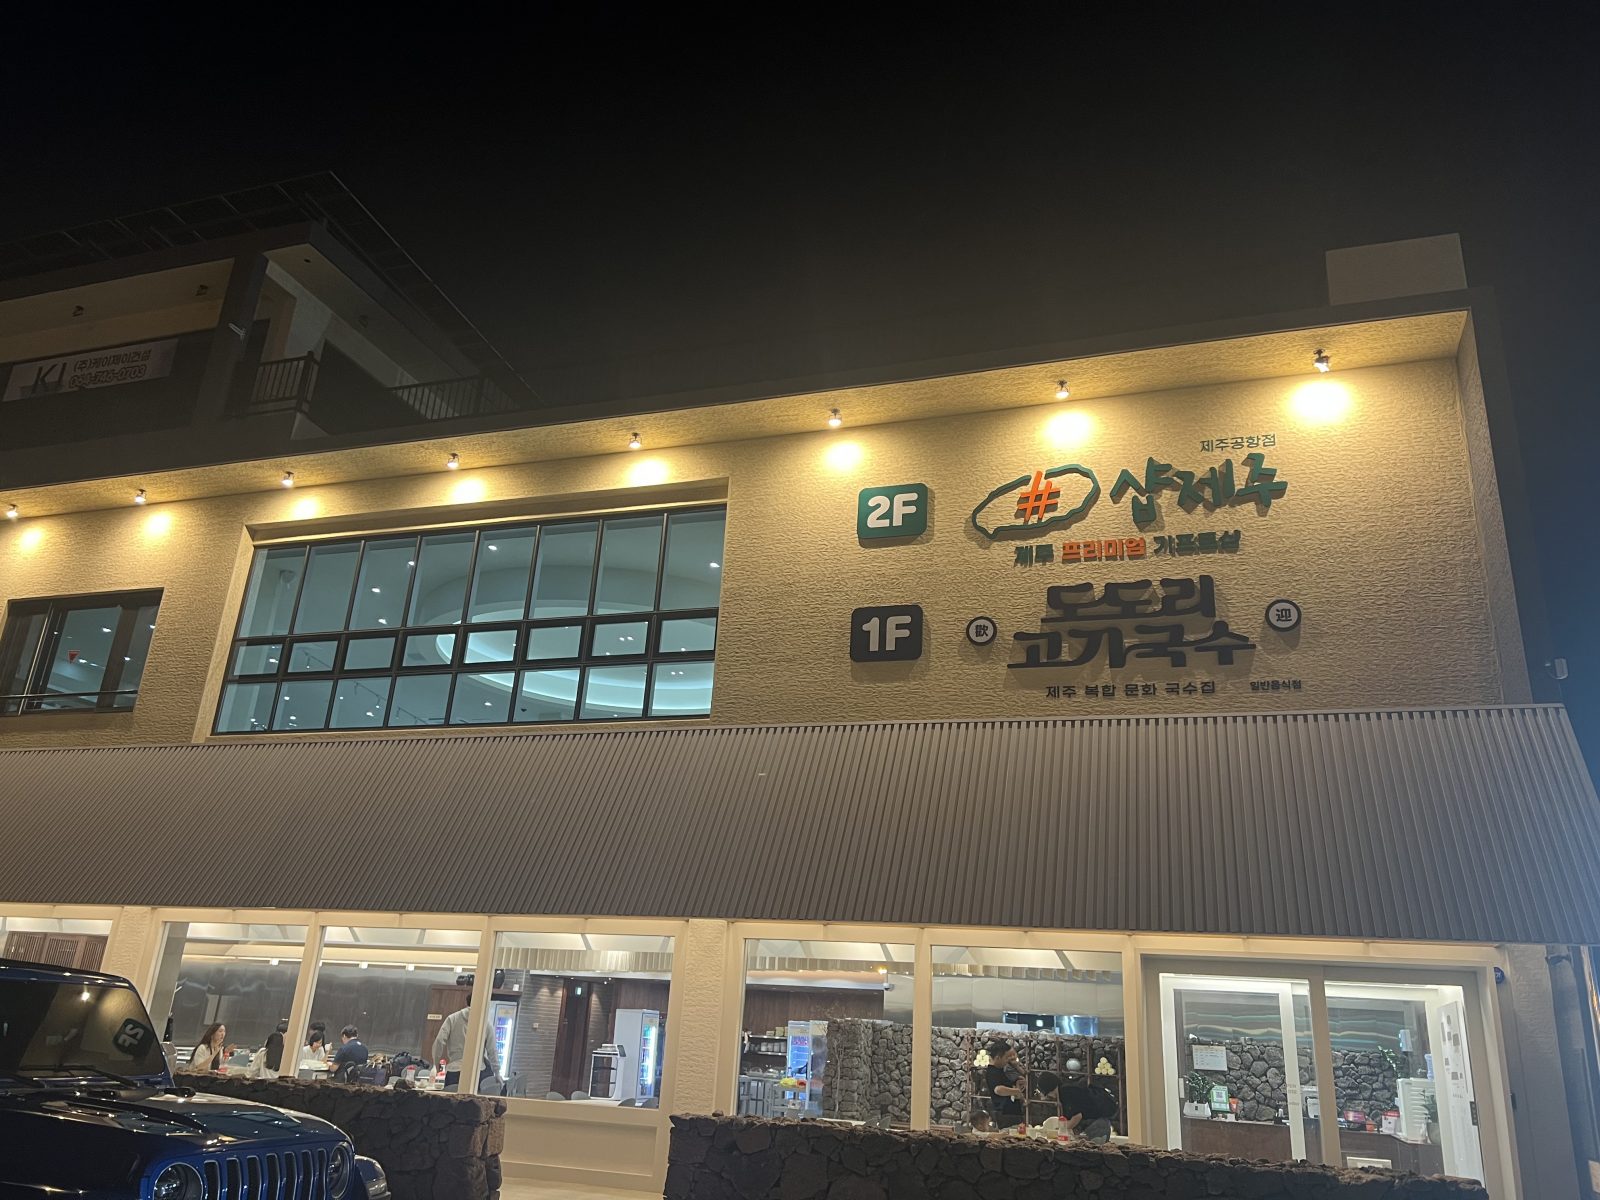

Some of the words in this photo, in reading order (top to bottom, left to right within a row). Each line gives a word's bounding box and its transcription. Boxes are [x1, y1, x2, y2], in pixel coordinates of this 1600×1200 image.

[1199, 433, 1276, 453] 제주공항점
[1109, 452, 1289, 524] 샵제주
[866, 492, 919, 529] 2F
[1062, 537, 1146, 563] 프리미엄
[861, 615, 912, 652] 1F
[1006, 619, 1257, 669] 고기국수
[1045, 685, 1077, 699] 제주
[1084, 684, 1117, 698] 복합
[1124, 683, 1157, 697] 문화
[1164, 681, 1217, 695] 국수집
[1249, 679, 1302, 692] 일반음식점
